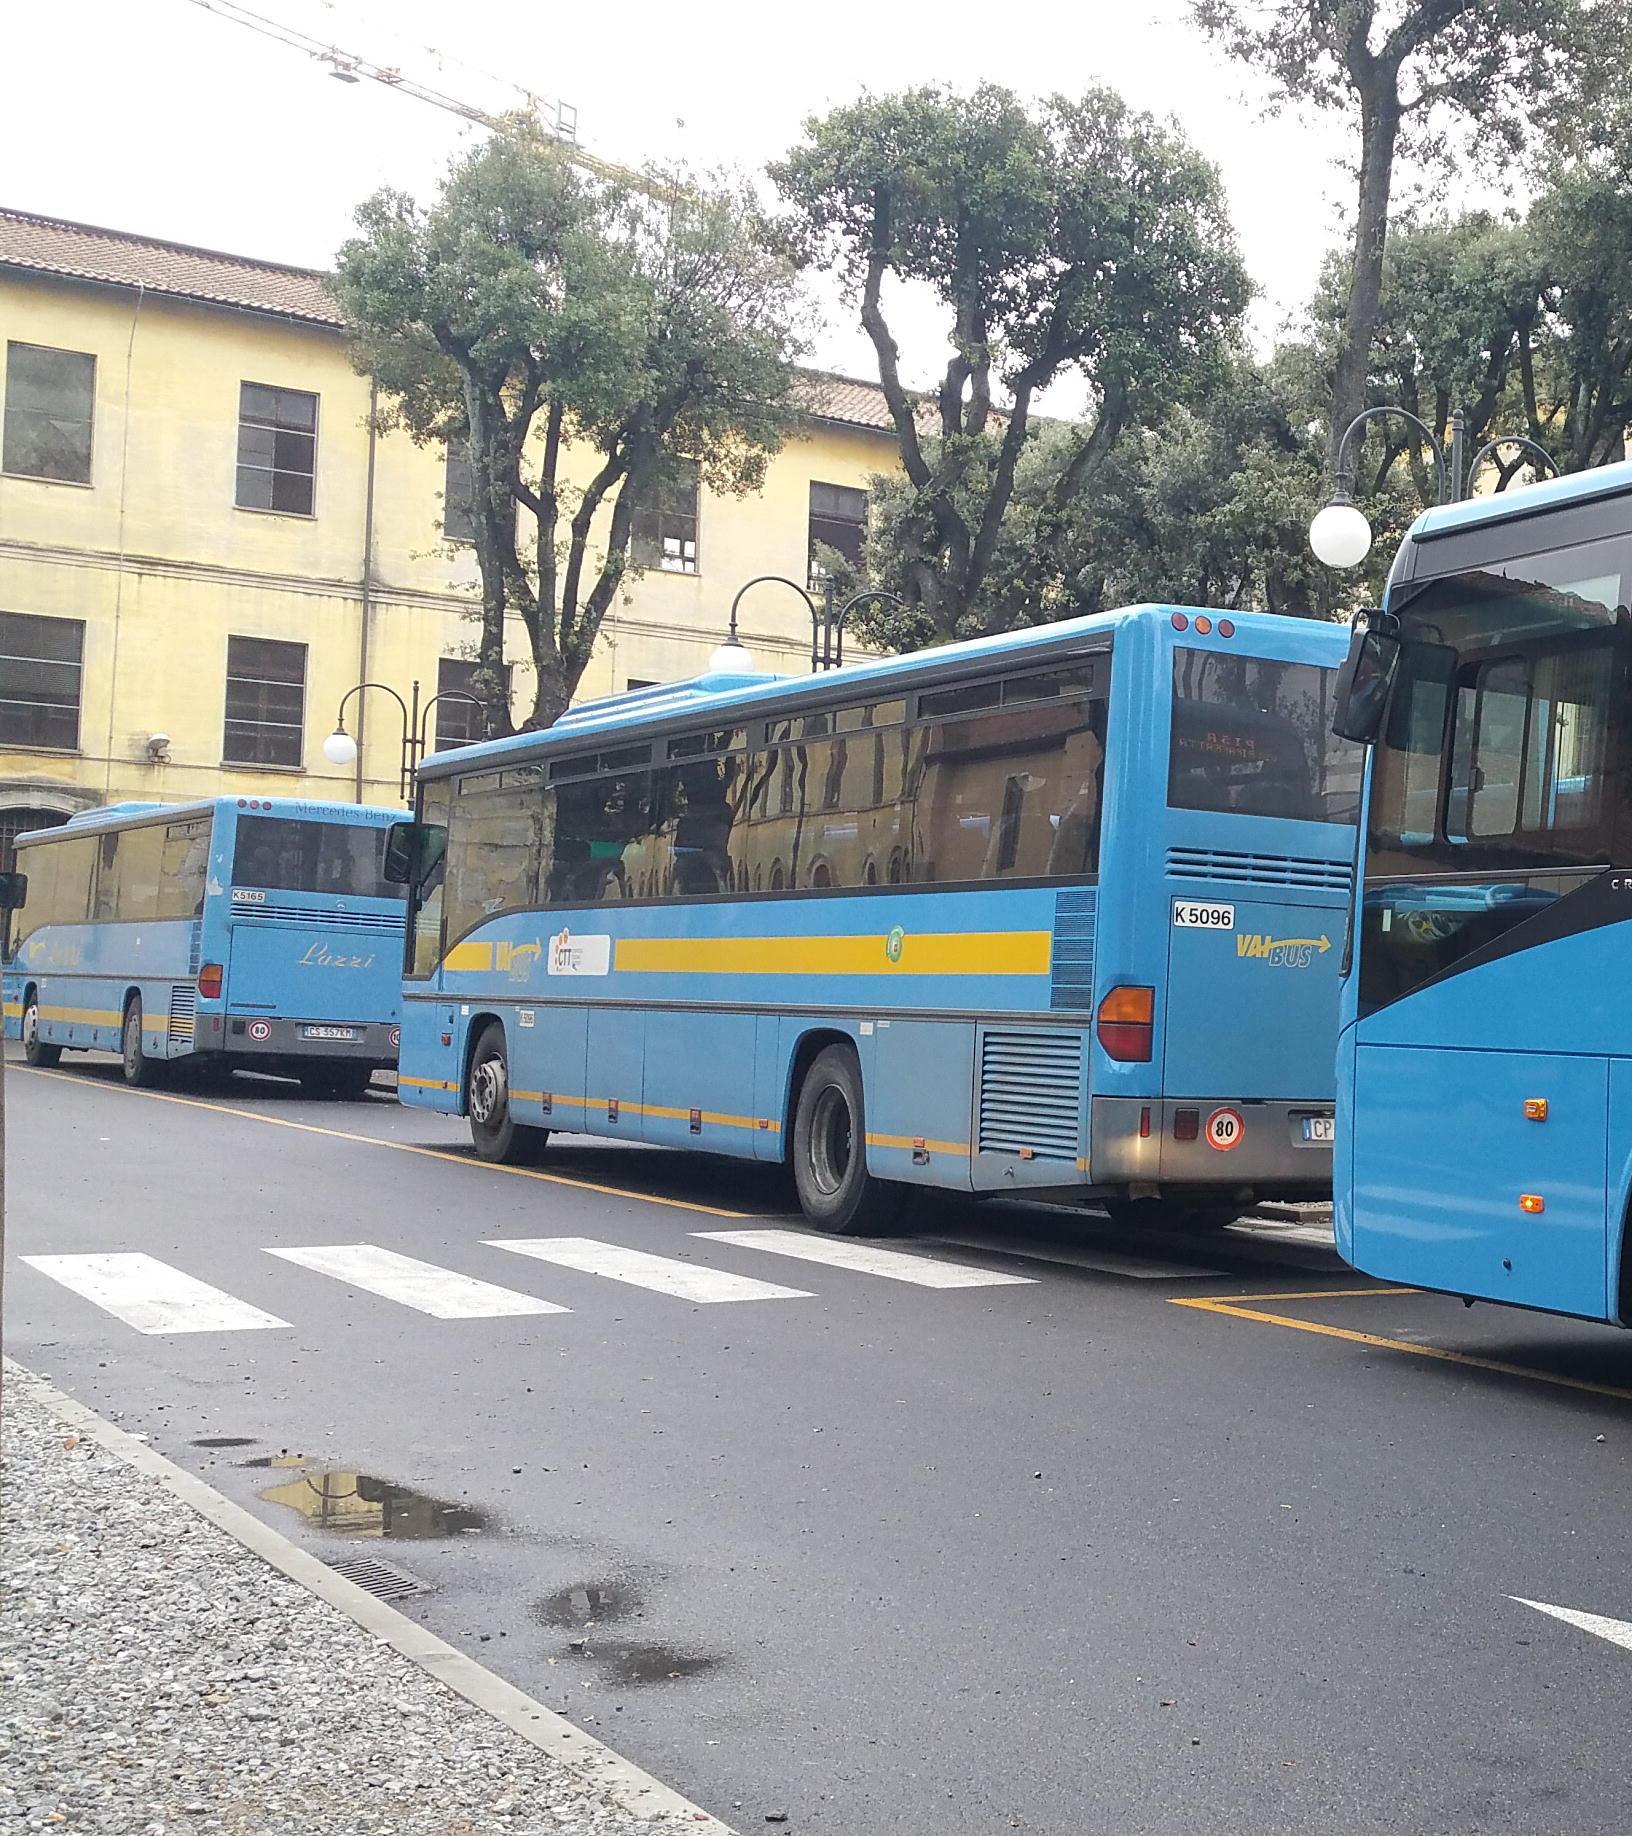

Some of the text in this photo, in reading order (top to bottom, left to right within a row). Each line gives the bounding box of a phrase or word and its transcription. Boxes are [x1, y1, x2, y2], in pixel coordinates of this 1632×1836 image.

[295, 802, 397, 822] Mercedes-Benz
[233, 889, 263, 901] K5165
[298, 942, 375, 968] Lazzi
[1268, 944, 1312, 967] BUS
[254, 1026, 265, 1035] 80
[1216, 1121, 1233, 1137] 80
[1314, 1120, 1331, 1138] CP
